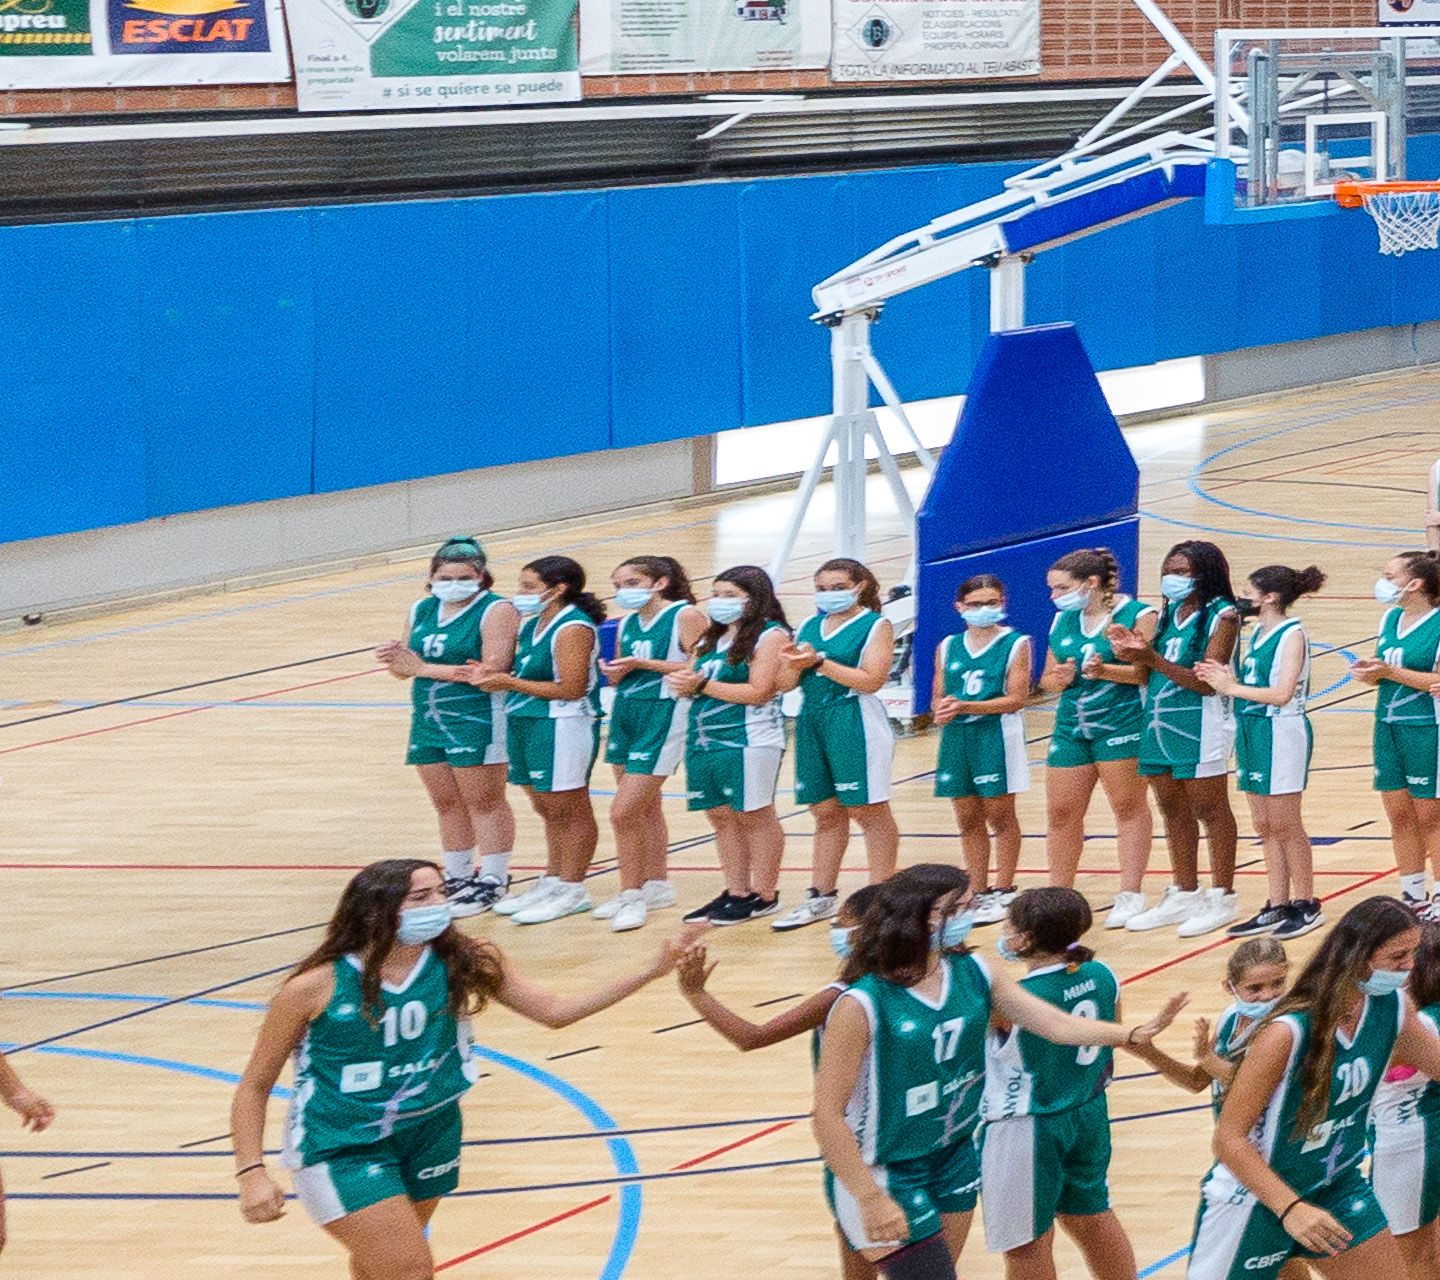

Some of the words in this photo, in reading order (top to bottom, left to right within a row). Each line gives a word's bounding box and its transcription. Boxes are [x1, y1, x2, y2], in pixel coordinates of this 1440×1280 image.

[435, 2, 441, 17] i
[448, 2, 463, 17] el
[469, 3, 528, 16] nostre
[122, 18, 255, 44] ESCLAT
[433, 19, 537, 43] sentiment
[436, 46, 505, 63] volarem
[508, 46, 558, 64] junts
[398, 85, 410, 98] si
[415, 87, 432, 97] se
[437, 84, 489, 100] quiere
[495, 84, 512, 95] se
[517, 80, 564, 97] puede
[423, 634, 445, 657] 15
[962, 670, 984, 695] 16
[1107, 733, 1140, 746] CBFC
[1064, 979, 1096, 1001] MIMI
[378, 1001, 426, 1046] 10
[932, 1017, 964, 1063] 17
[1335, 1057, 1370, 1105] 20
